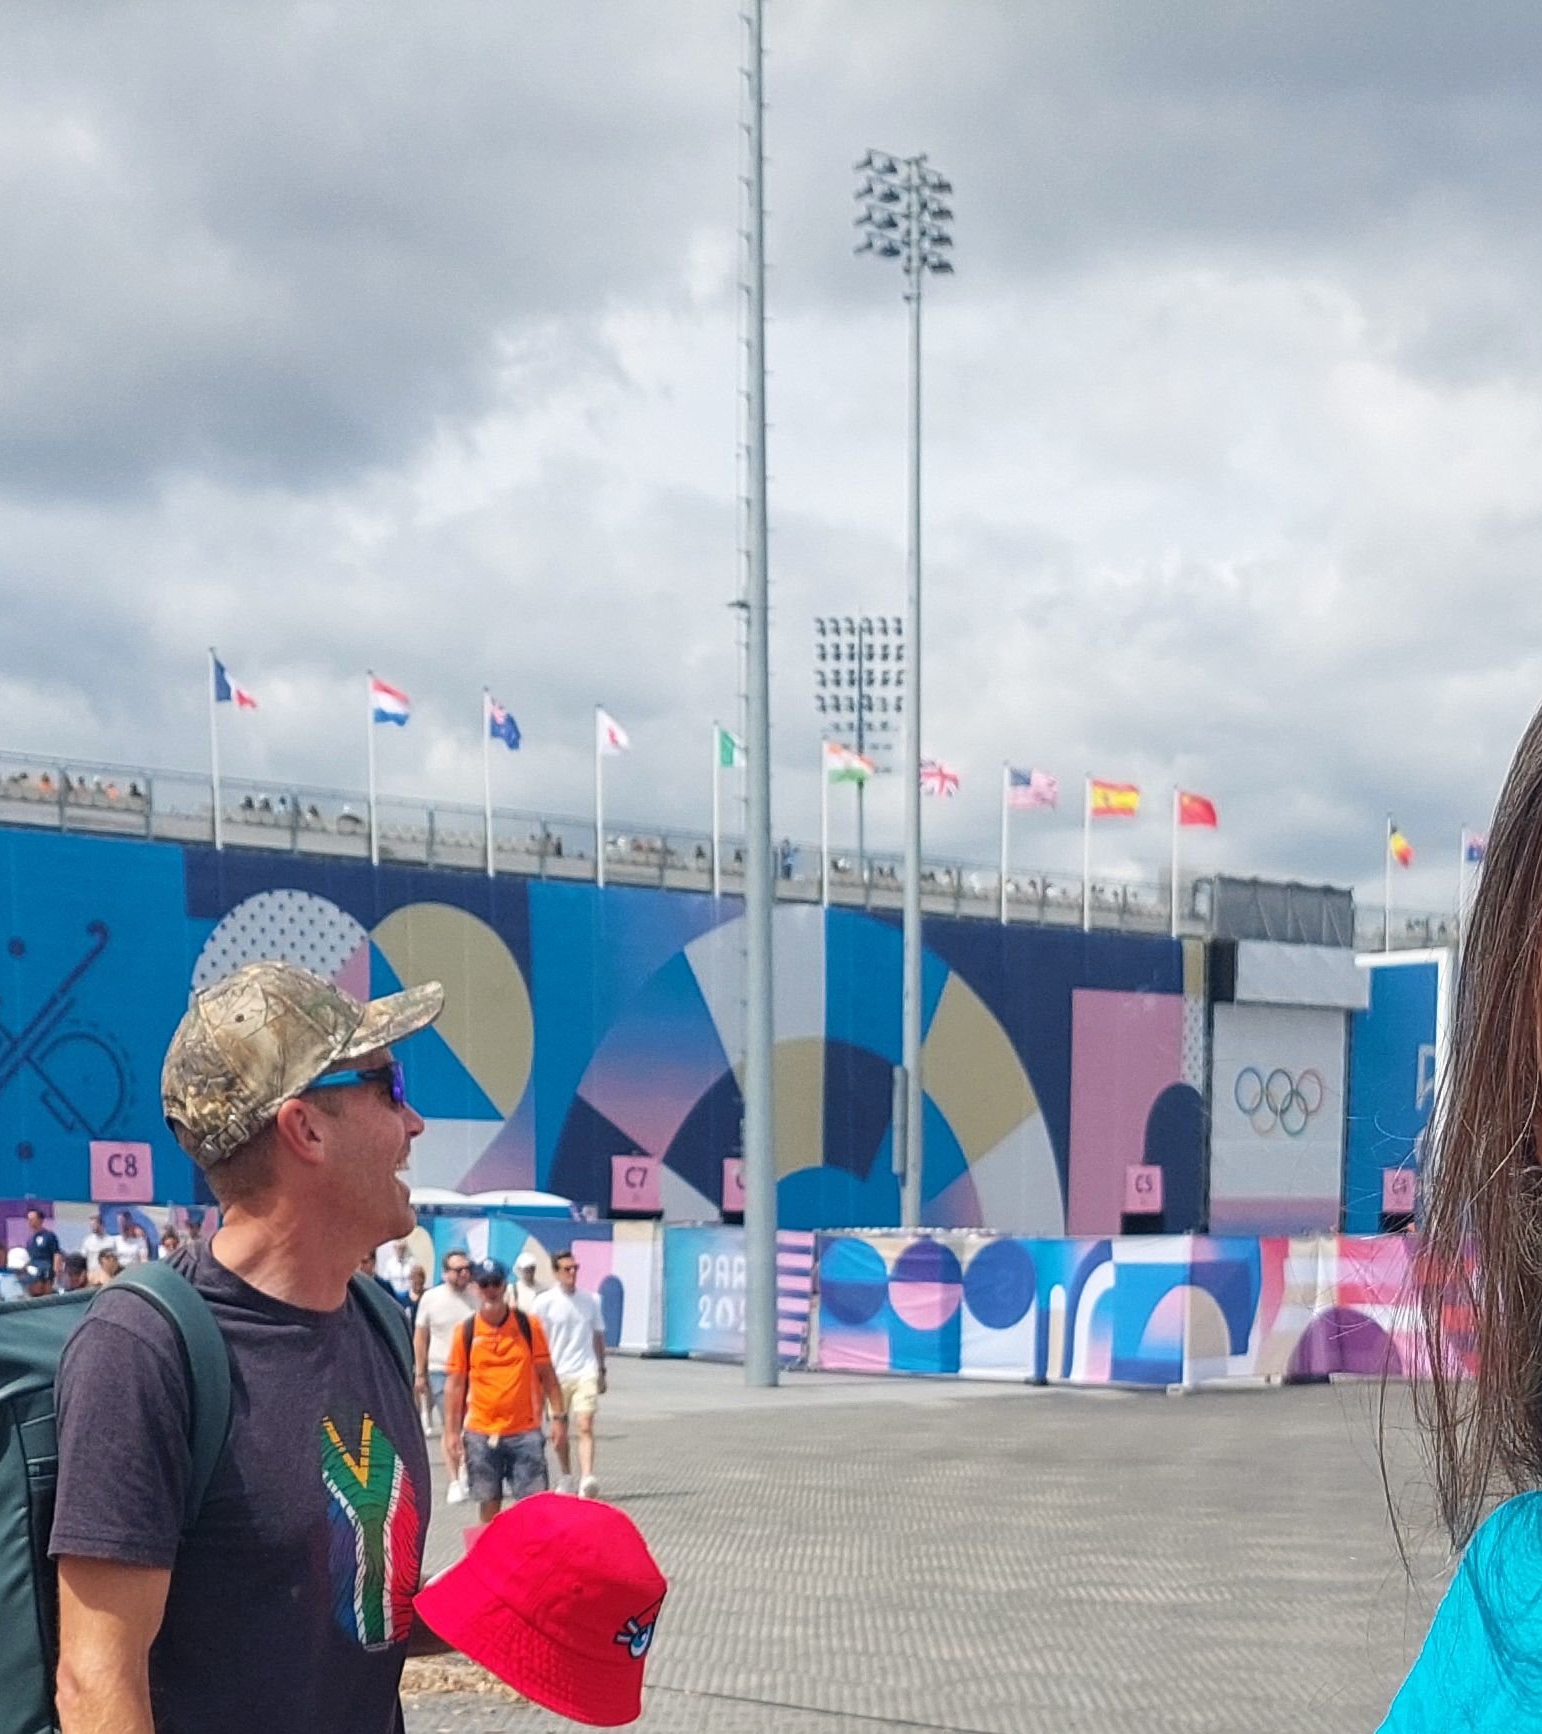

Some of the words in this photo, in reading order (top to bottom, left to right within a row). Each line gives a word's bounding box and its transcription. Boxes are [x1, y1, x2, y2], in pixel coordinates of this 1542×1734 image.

[108, 1153, 138, 1178] C8
[624, 1166, 647, 1188] C7
[698, 1253, 747, 1289] PAR
